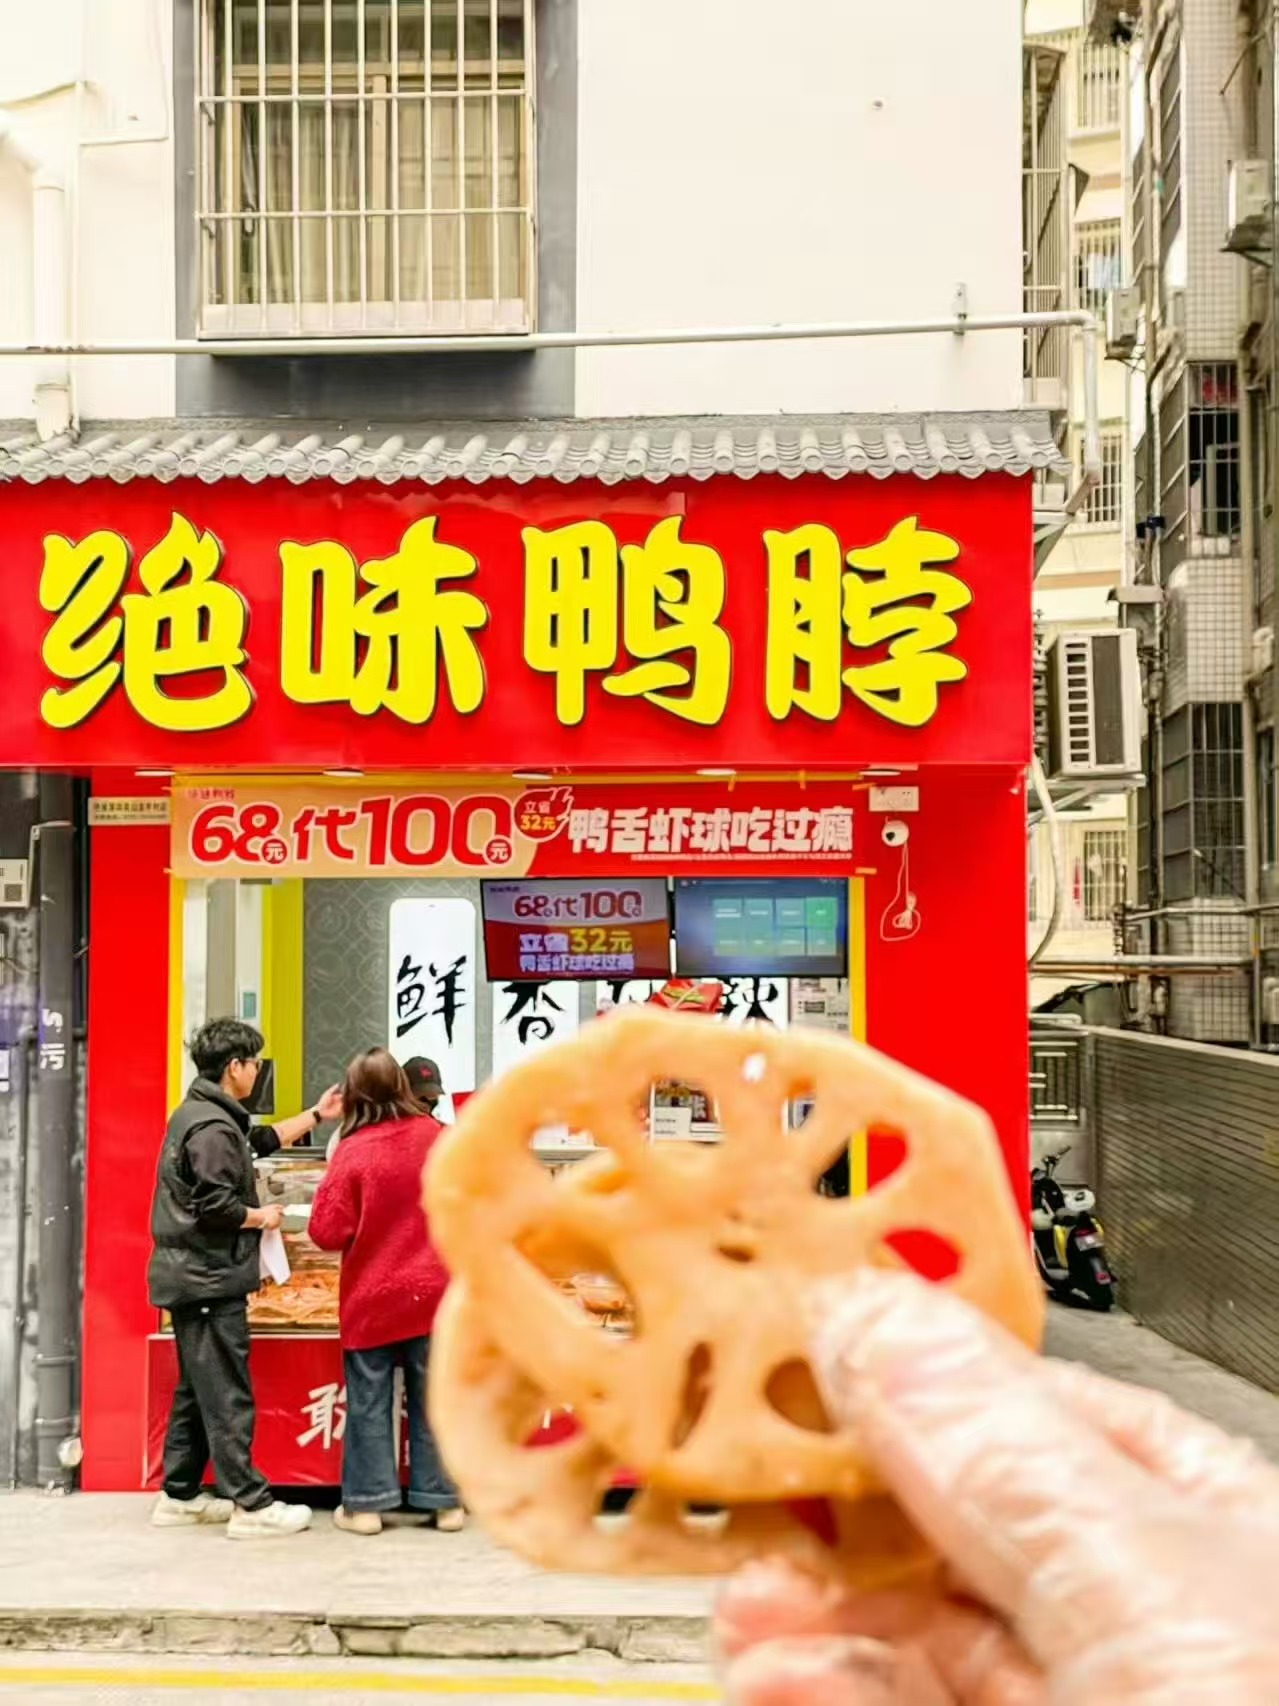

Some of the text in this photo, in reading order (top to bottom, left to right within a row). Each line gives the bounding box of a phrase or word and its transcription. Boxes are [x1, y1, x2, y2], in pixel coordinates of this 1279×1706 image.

[40, 511, 973, 731] 绝味鸭脖
[520, 814, 556, 831] 32元
[568, 806, 853, 853] 鸭舌虾球吃过瘾
[396, 955, 467, 1047] 鲜
